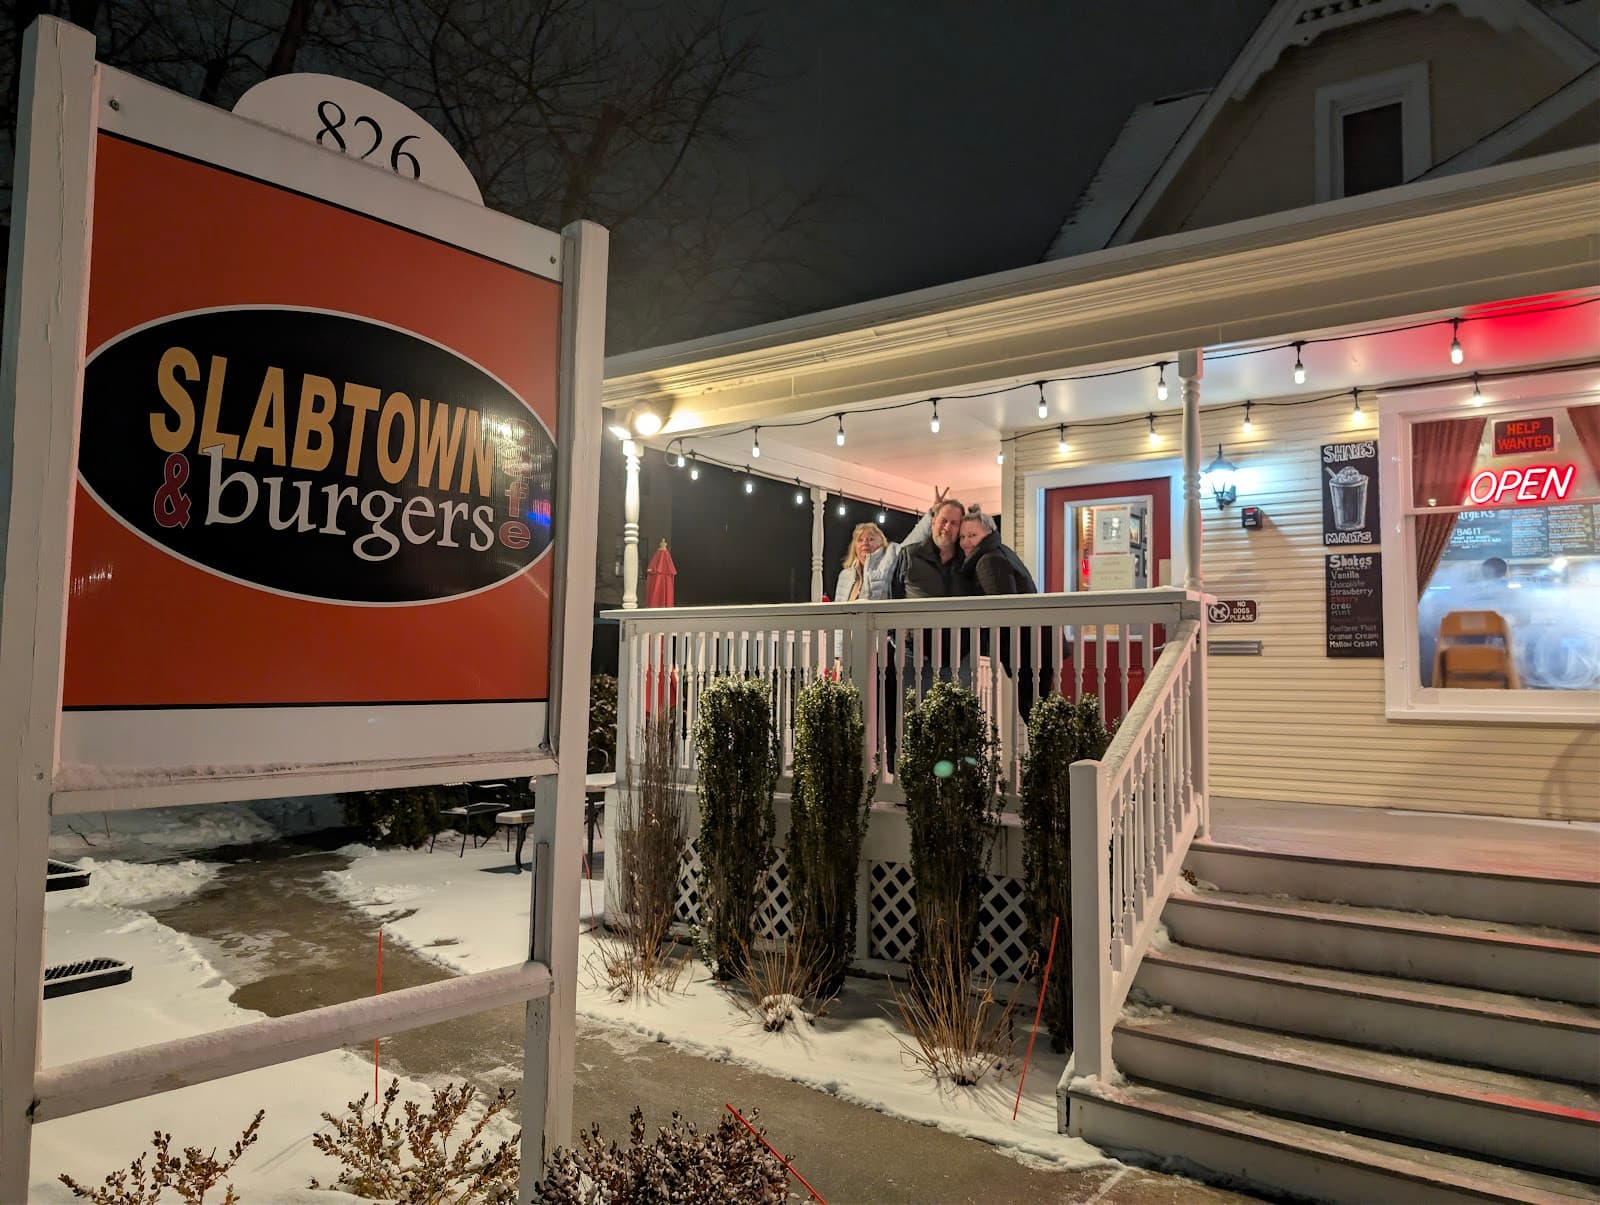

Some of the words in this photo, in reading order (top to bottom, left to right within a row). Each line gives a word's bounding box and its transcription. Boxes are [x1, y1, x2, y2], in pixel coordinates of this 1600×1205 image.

[316, 100, 421, 181] 826
[149, 346, 493, 497] SLABTOWN
[1506, 421, 1540, 435] HELP
[1497, 434, 1552, 451] WANTED
[1323, 440, 1376, 463] SHAKES
[1470, 466, 1574, 504] OPEN
[201, 443, 495, 562] burgers
[1325, 531, 1373, 544] MALTS
[1329, 554, 1374, 568] Shakes
[1330, 570, 1361, 580] Vanilla
[1330, 588, 1374, 597] Strawberry
